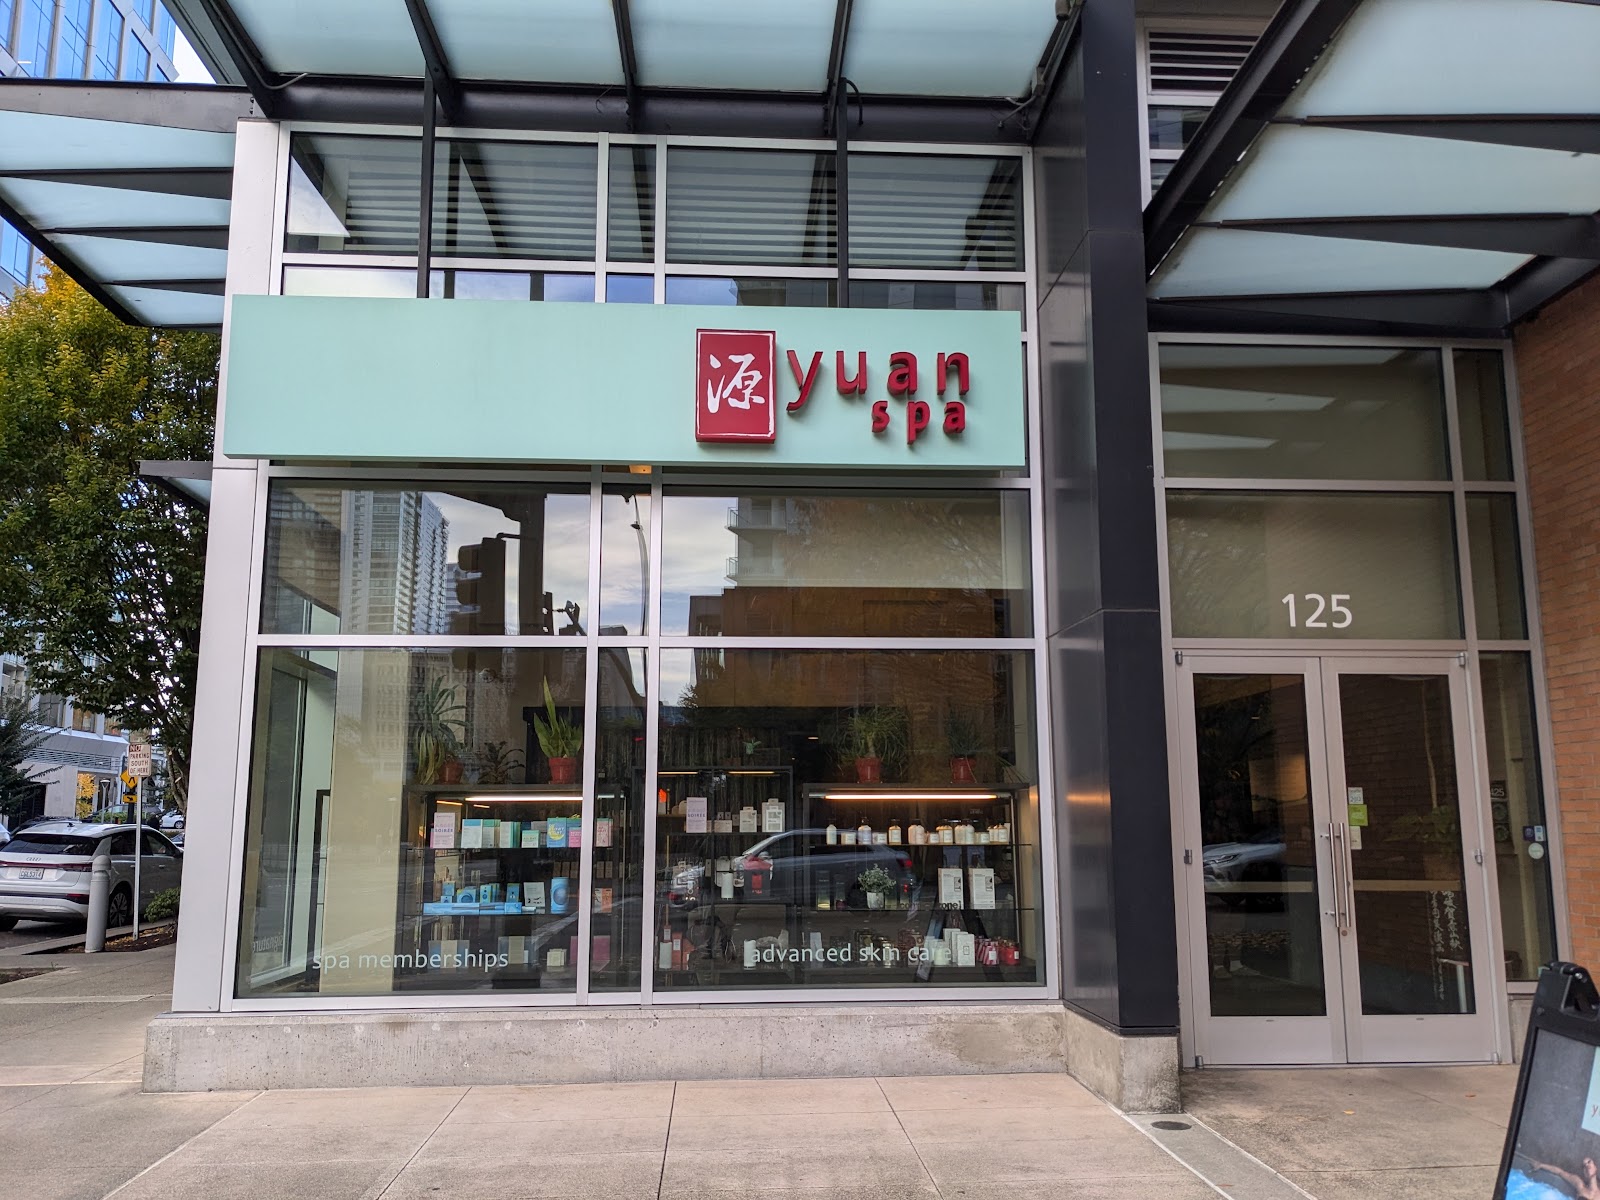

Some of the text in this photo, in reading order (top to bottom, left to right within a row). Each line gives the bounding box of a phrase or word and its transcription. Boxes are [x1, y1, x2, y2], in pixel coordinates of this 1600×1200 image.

[707, 353, 765, 413] 源
[786, 350, 970, 411] yuan
[871, 400, 966, 444] spa
[1281, 593, 1353, 628] 125
[312, 949, 509, 974] spa memberships
[751, 942, 951, 963] advanced skin care
